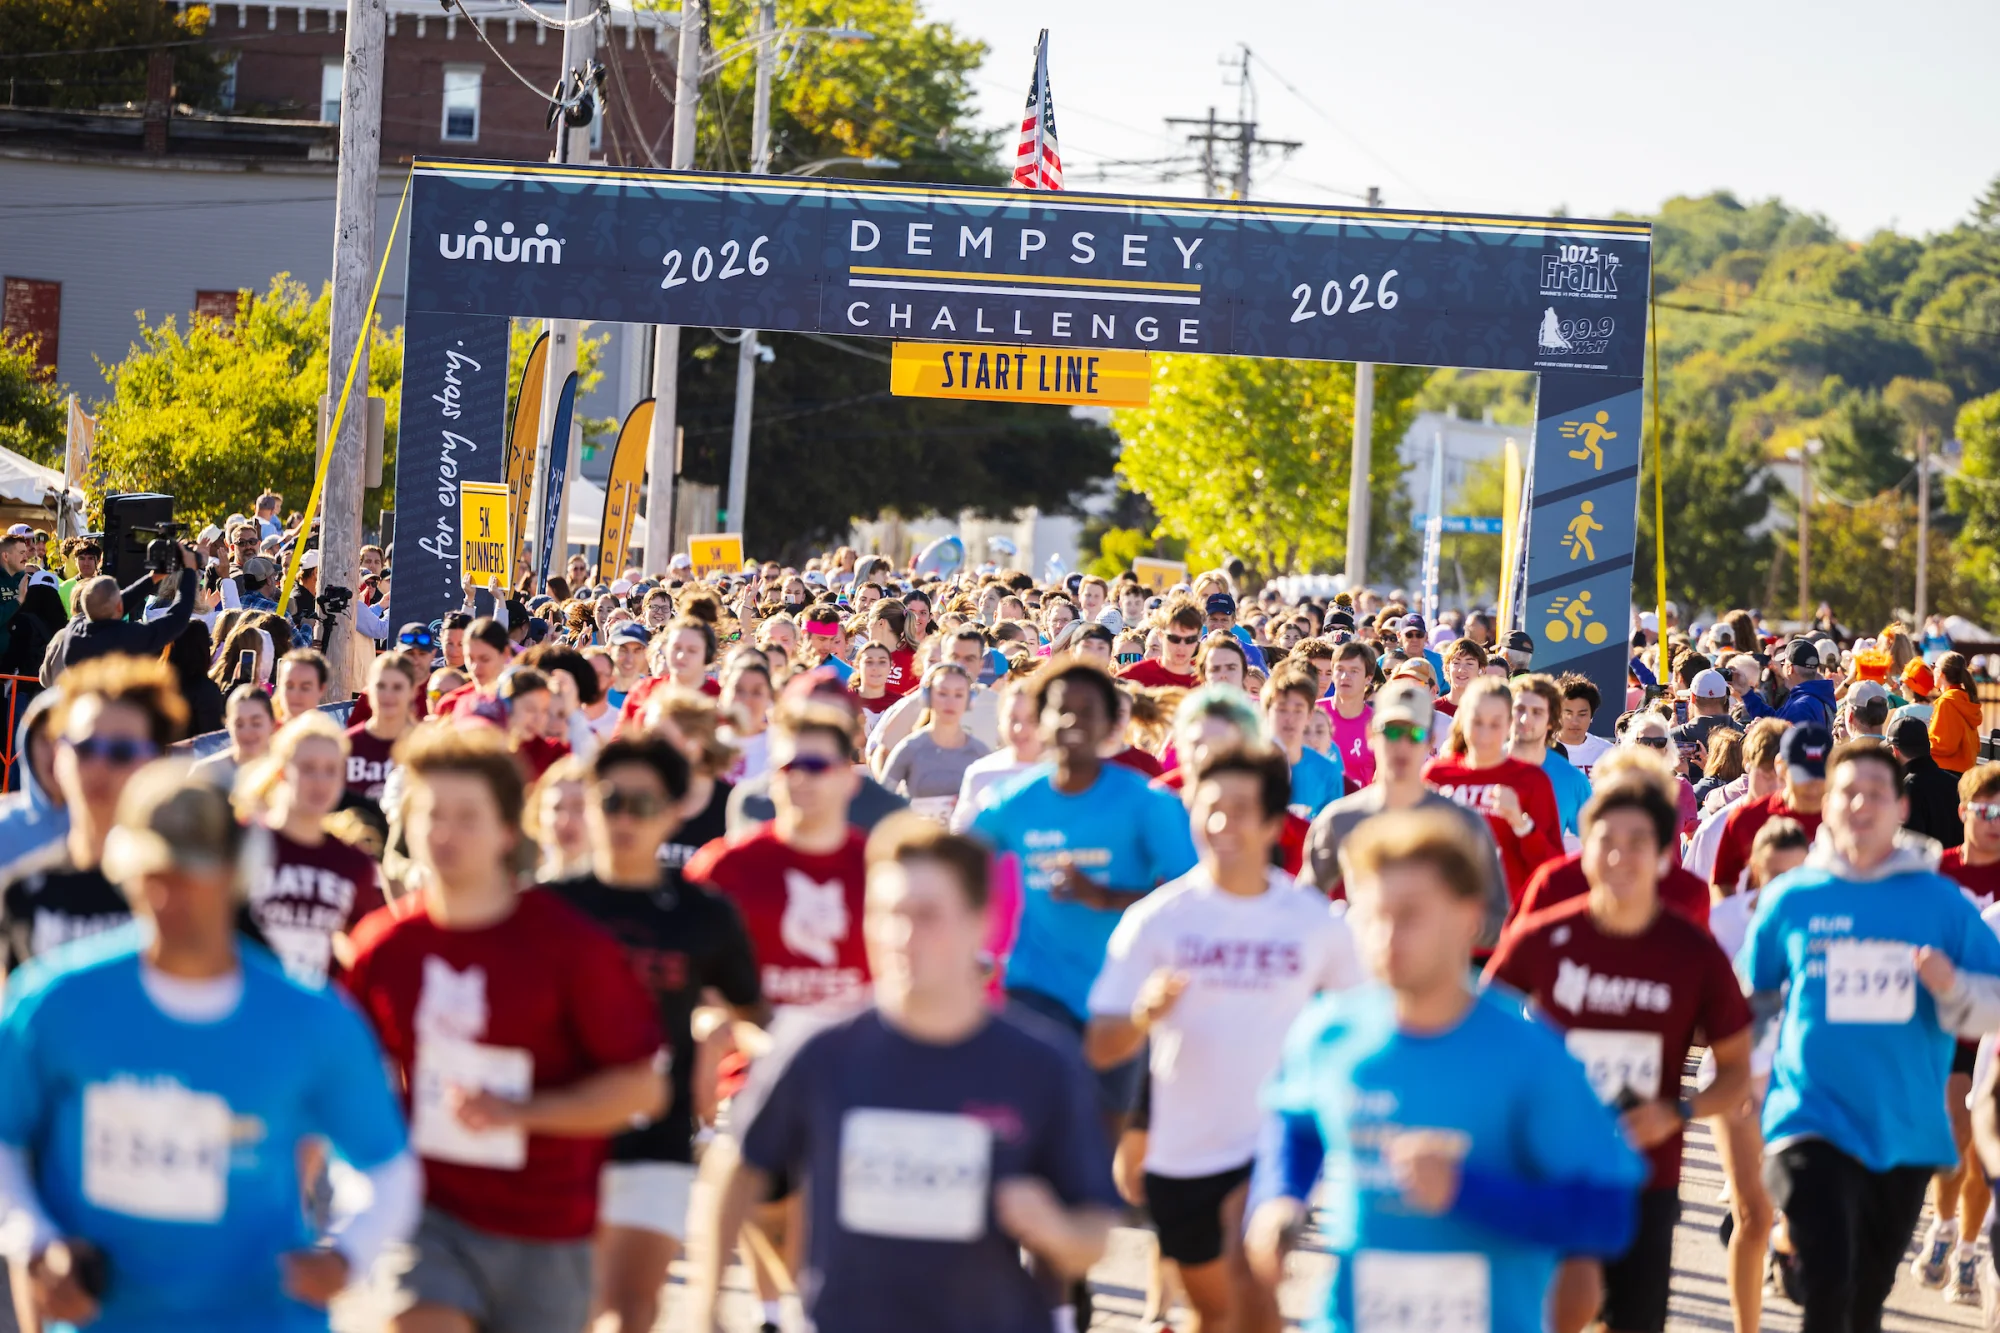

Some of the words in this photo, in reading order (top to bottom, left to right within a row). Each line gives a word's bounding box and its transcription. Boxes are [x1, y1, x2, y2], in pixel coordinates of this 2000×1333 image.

[439, 219, 566, 264] unum
[849, 219, 1204, 270] DEMPSEY
[1560, 245, 1599, 264] 107.5
[1608, 253, 1620, 264] fm
[661, 235, 770, 290] 2026
[1540, 254, 1618, 293] Frank
[1290, 269, 1398, 323] 2026
[847, 301, 1200, 345] CHALLENGE
[1559, 316, 1615, 340] 99.9
[1571, 340, 1608, 355] Wolf
[942, 351, 1028, 391] START
[1039, 355, 1100, 394] LINE
[437, 429, 478, 507] every
[479, 507, 491, 538] 5K
[465, 540, 505, 574] RUNNERS
[346, 756, 395, 783] Bat
[1833, 968, 1912, 997] 2399
